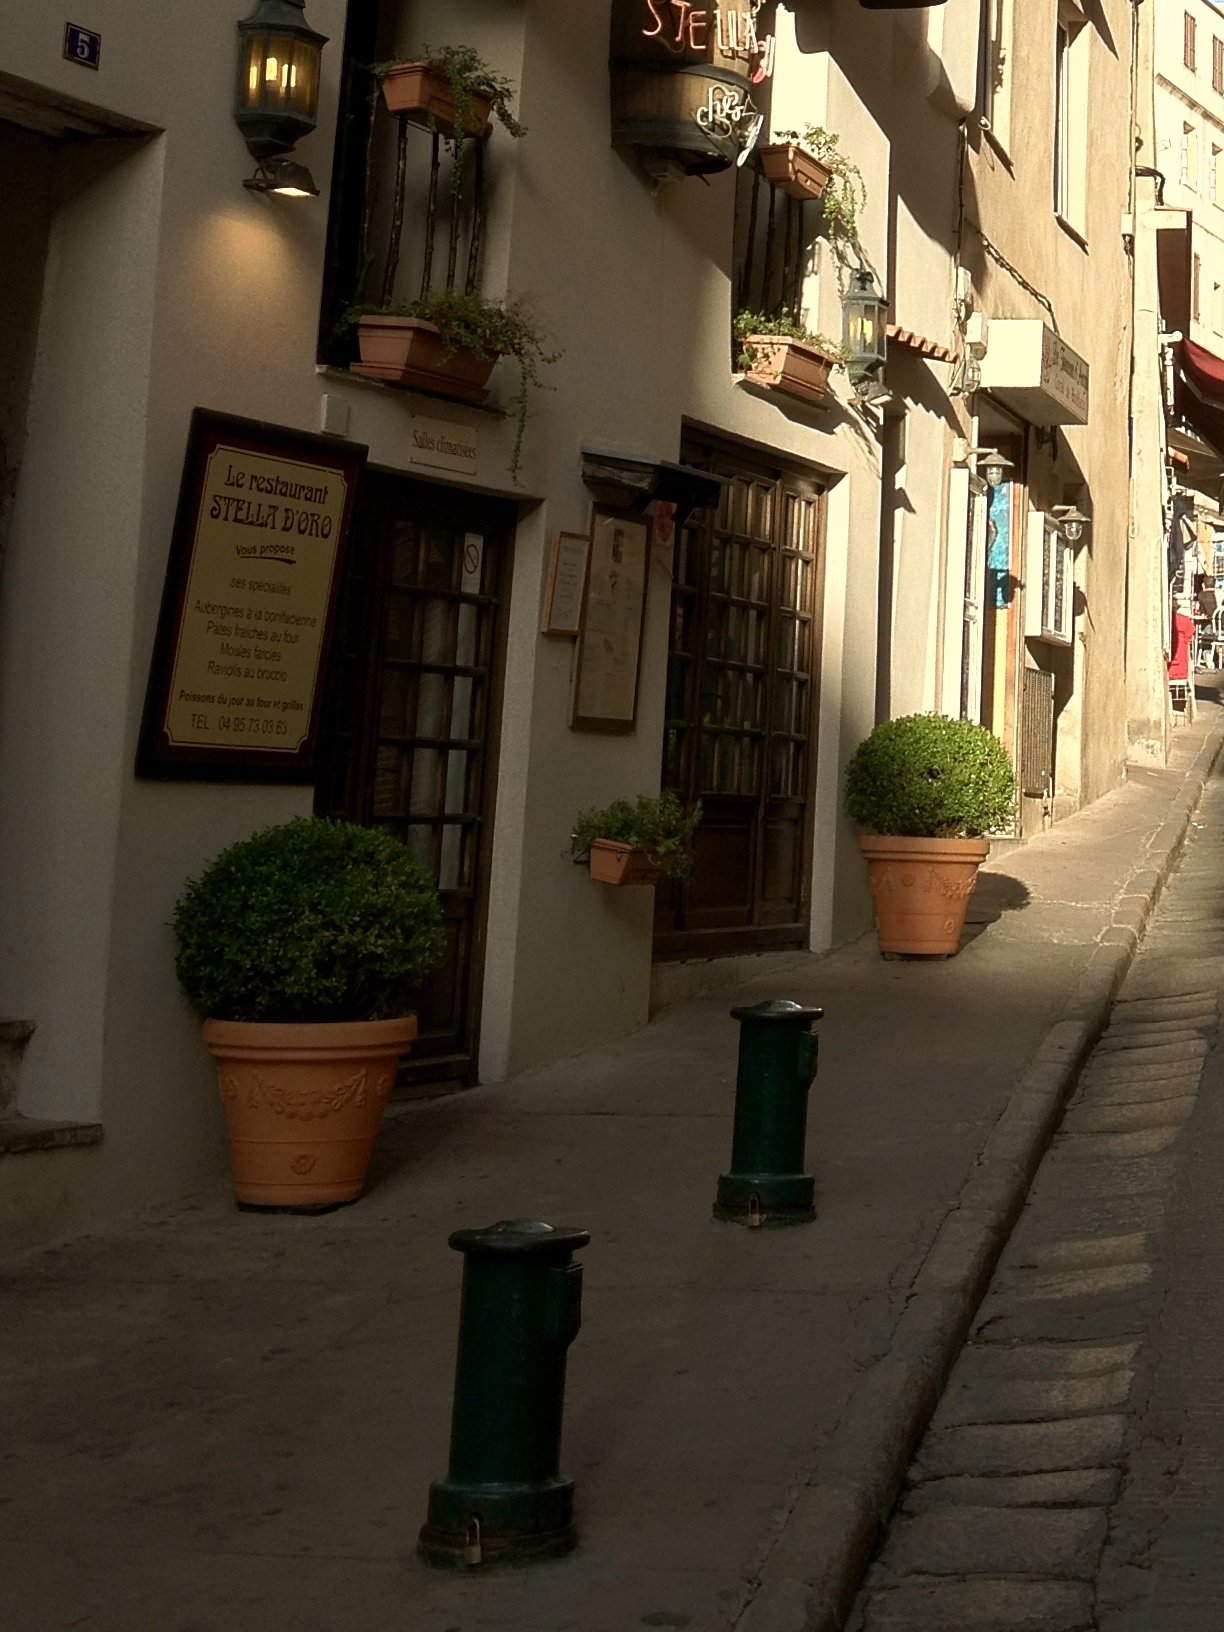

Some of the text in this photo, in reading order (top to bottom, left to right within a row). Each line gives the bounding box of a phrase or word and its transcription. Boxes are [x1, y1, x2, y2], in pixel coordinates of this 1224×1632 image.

[77, 32, 90, 59] 5
[412, 429, 436, 451] Salles
[224, 464, 329, 505] Le restaurant
[210, 494, 333, 540] STELLA D'ORO
[235, 544, 296, 556] Vous propose
[230, 577, 246, 590] ses
[194, 599, 245, 620] Aubergines
[254, 609, 263, 621] la
[264, 610, 318, 628] bonifacienne
[270, 630, 283, 643] au
[283, 631, 300, 645] four
[219, 641, 282, 663] Moules farcies
[206, 660, 289, 683] Raviolis au bruccio
[216, 693, 228, 706] du
[227, 695, 245, 708] jour
[245, 696, 256, 708] au
[256, 696, 273, 710] four
[190, 713, 289, 736] TEL 04 95 73 03 63
